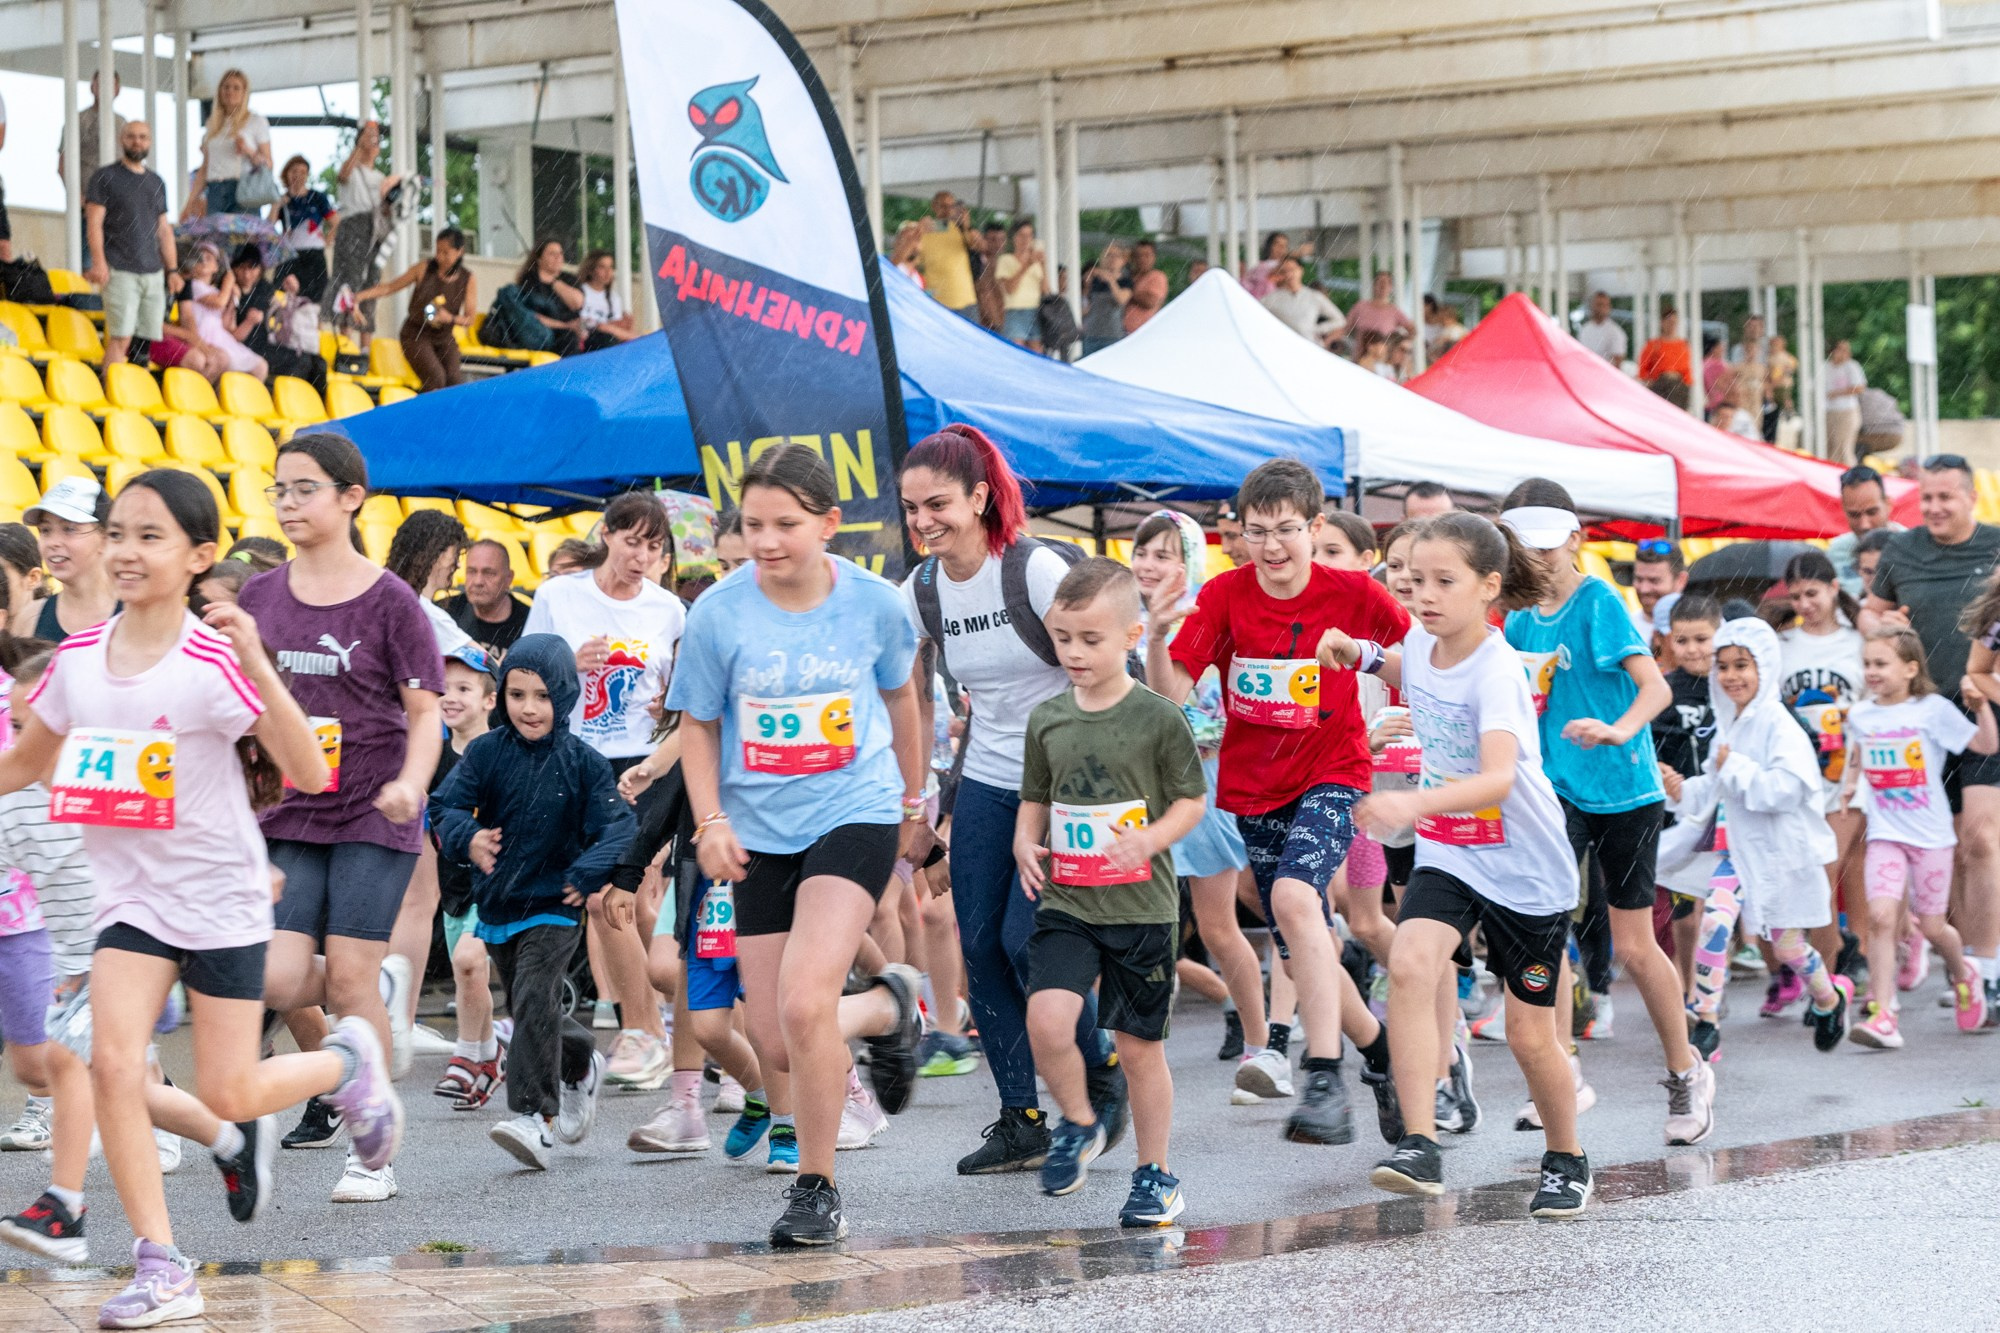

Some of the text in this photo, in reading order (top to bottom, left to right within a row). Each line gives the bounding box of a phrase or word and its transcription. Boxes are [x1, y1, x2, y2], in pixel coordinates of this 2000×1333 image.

[963, 614, 990, 635] ми
[993, 608, 1011, 628] се
[277, 650, 340, 676] PUMA
[1237, 671, 1273, 697] 63
[757, 713, 802, 739] 99
[76, 748, 115, 781] 74
[1869, 749, 1897, 766] 111
[1064, 822, 1095, 850] 10
